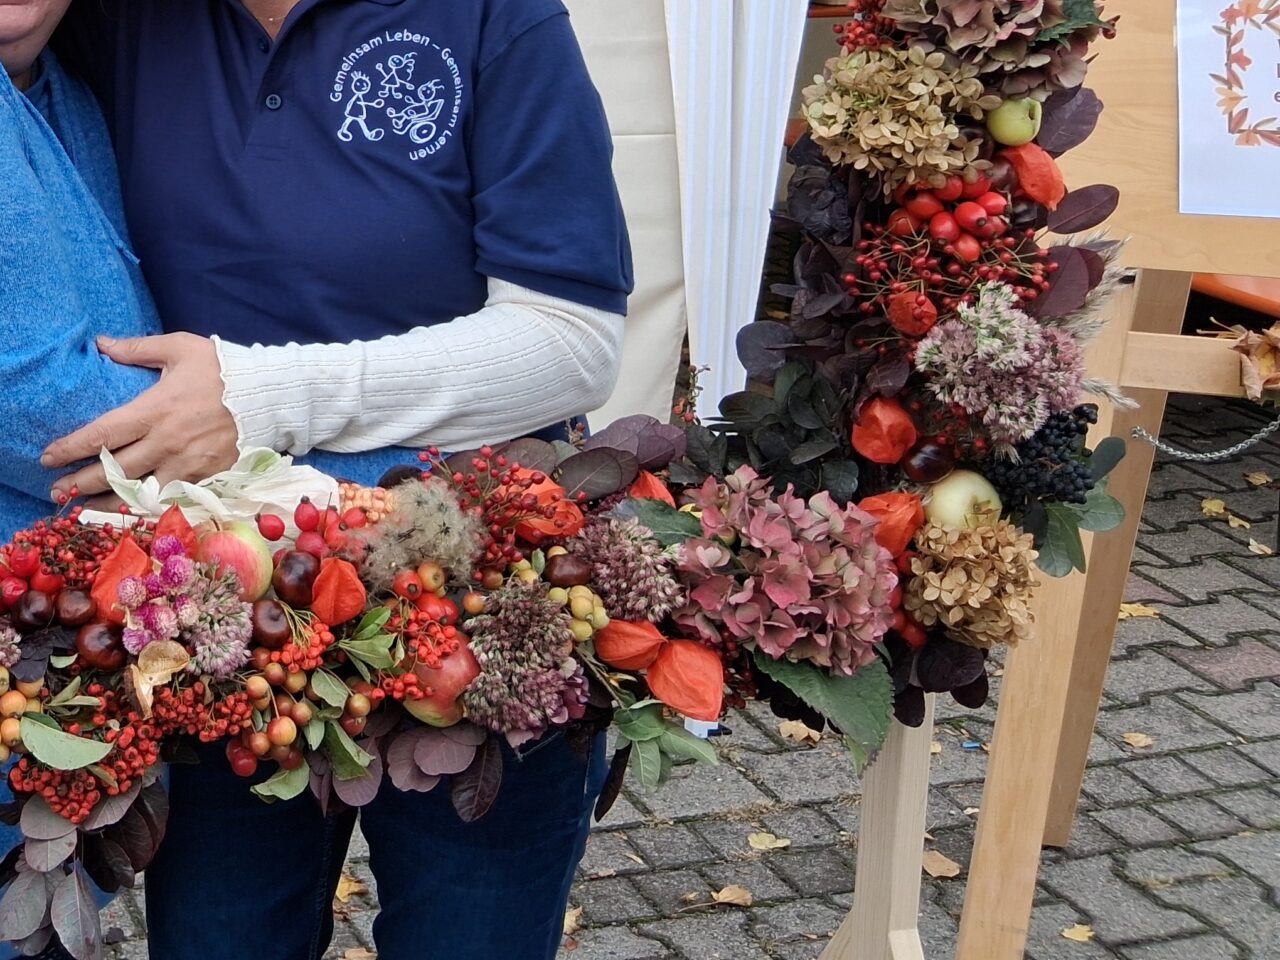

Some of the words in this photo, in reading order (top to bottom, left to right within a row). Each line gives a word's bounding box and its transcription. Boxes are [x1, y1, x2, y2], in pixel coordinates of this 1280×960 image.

[385, 29, 430, 46] Leben
[330, 36, 383, 102] Gemeinsam
[441, 48, 464, 127] Gemeinsam
[409, 129, 453, 161] Lernen
